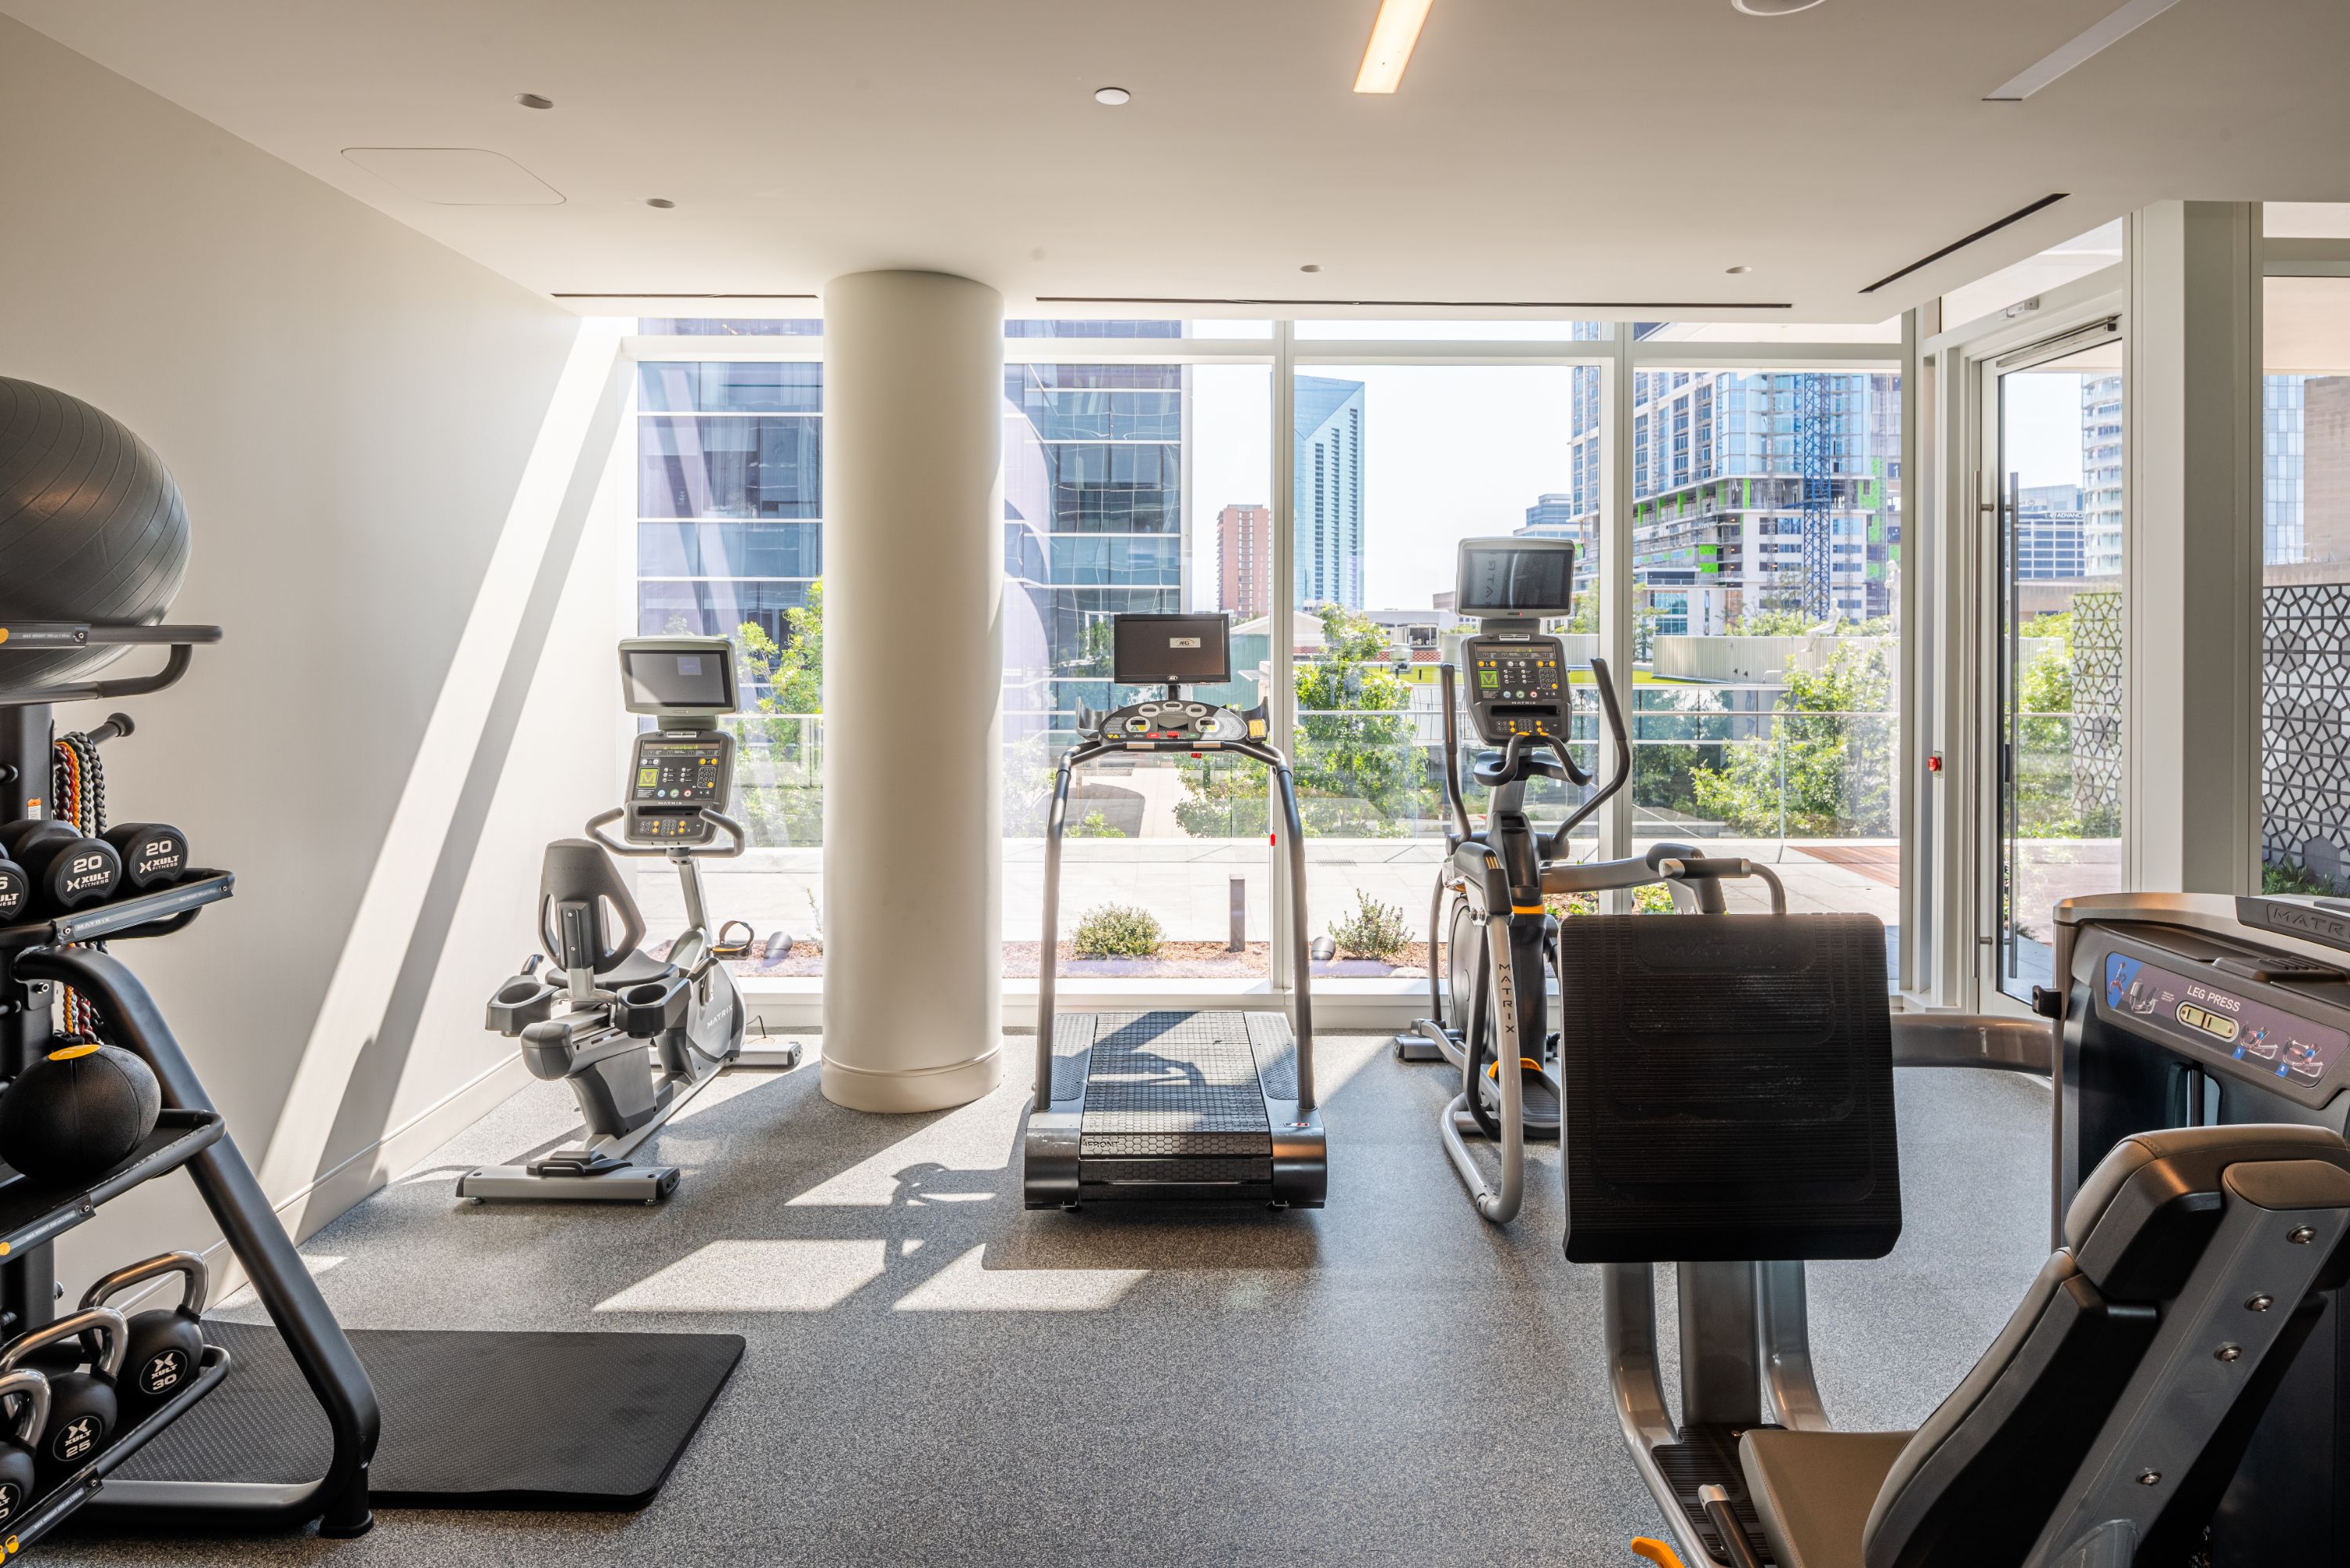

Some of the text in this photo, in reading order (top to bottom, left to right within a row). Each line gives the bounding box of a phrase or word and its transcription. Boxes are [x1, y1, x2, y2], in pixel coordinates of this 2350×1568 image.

[146, 840, 172, 856] 20
[74, 855, 103, 873] 20
[152, 862, 179, 871] FITNESS
[153, 854, 180, 867] XULT
[81, 870, 111, 883] XULT
[81, 878, 110, 889] FITNESS
[0, 893, 20, 902] ULT
[2273, 908, 2346, 937] MATR
[1499, 963, 1515, 1033] MATRIX
[2186, 985, 2206, 1000] LEG
[2207, 992, 2241, 1012] PRESS
[707, 1003, 733, 1029] MATRIX
[1082, 1138, 1119, 1148] 4FRONT
[151, 1364, 178, 1379] XULT
[153, 1373, 177, 1390] 30
[64, 1429, 92, 1447] XULT
[66, 1439, 91, 1458] 25
[0, 1507, 9, 1519] 0
